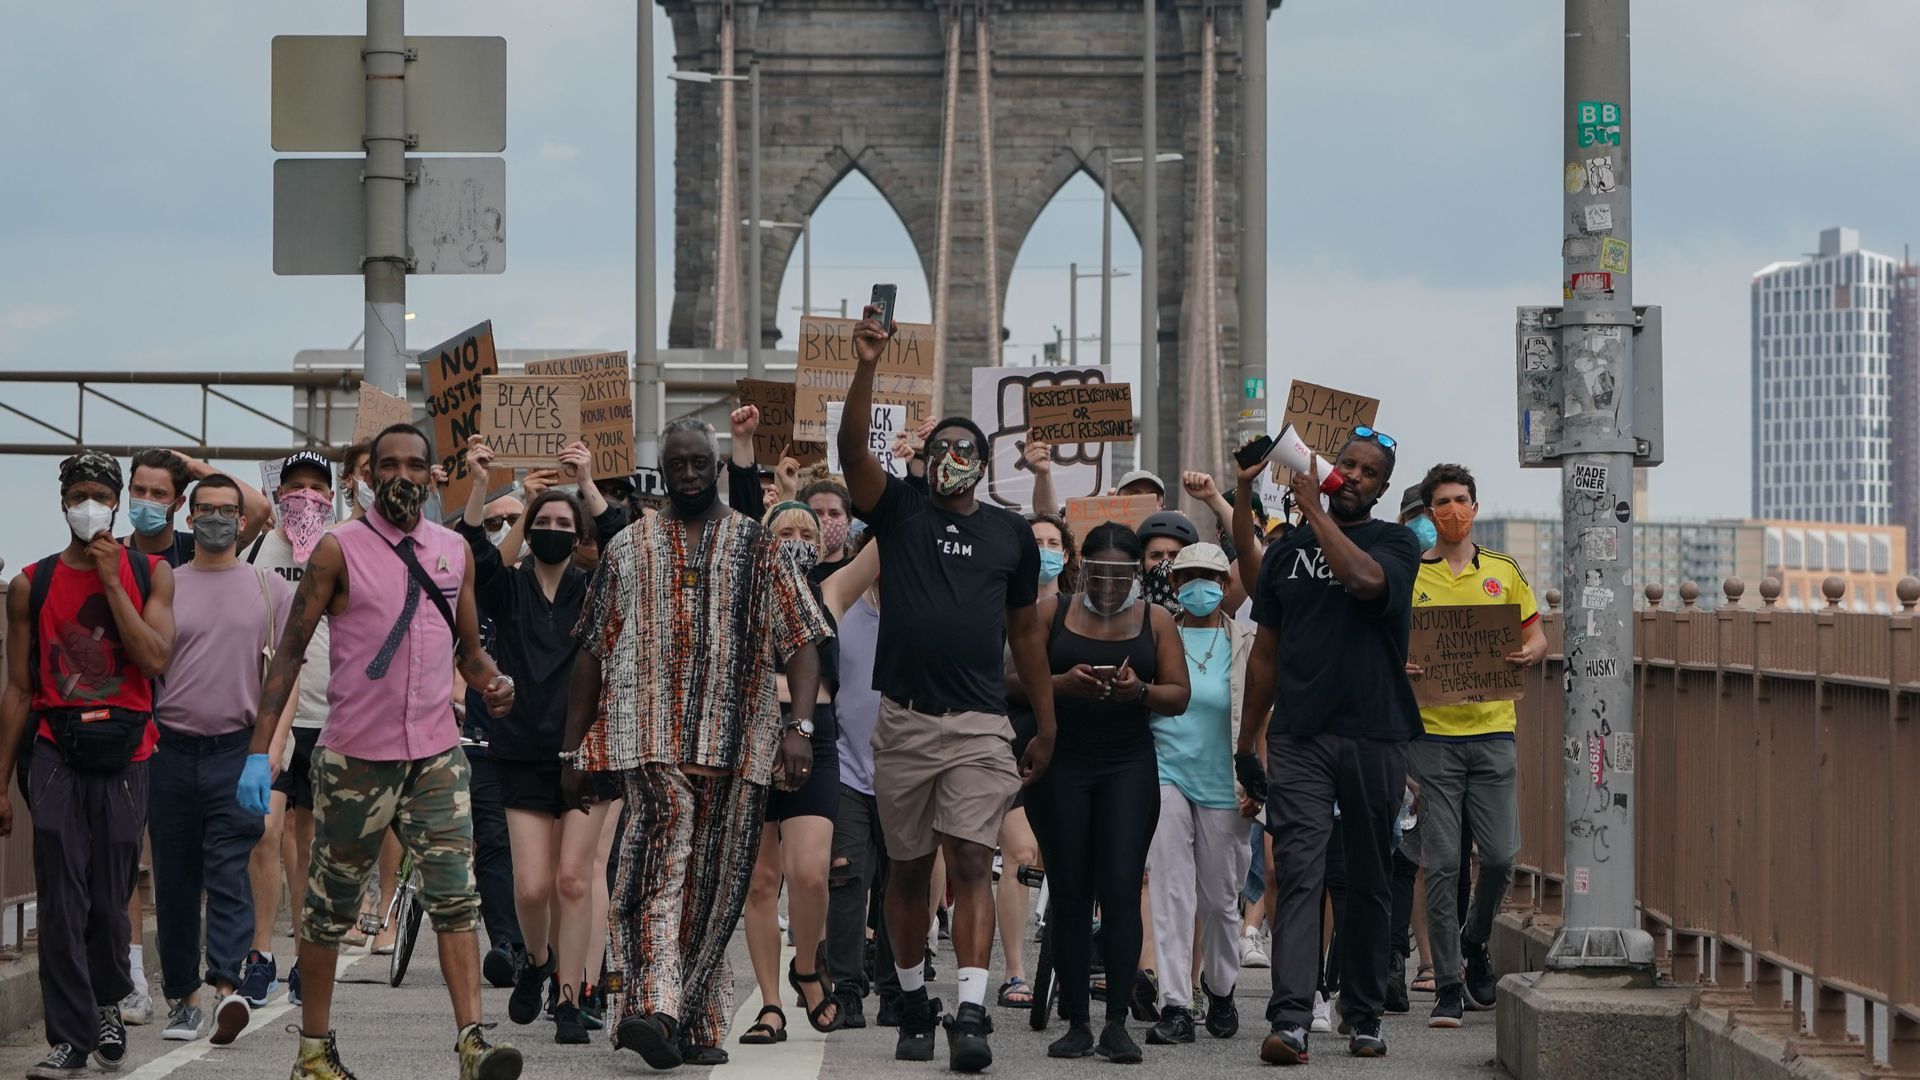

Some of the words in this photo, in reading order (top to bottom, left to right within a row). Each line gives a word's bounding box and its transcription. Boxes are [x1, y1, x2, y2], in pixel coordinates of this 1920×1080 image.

[805, 323, 921, 366] BRENA
[440, 335, 479, 382] NO
[570, 358, 593, 372] LIVES
[426, 367, 492, 418] JUSTIC
[497, 383, 560, 407] BLACK
[1029, 389, 1076, 407] RESPECT
[608, 404, 633, 420] LOVE
[1072, 407, 1090, 420] OR
[1288, 385, 1369, 425] BLACK
[494, 407, 562, 429] LIVES
[595, 430, 626, 448] YOUR
[1032, 422, 1076, 441] EXPECT
[486, 432, 567, 455] MATTER
[286, 454, 299, 466] ST.
[299, 450, 327, 467] PAULI
[1576, 466, 1606, 479] MADE
[1575, 478, 1605, 490] ONER
[1070, 498, 1137, 522] BLACK
[1436, 626, 1516, 650] ANYWHERE
[1424, 654, 1431, 662] a
[1440, 647, 1480, 660] threat
[1488, 647, 1501, 658] to
[1586, 658, 1617, 677] HUSKY
